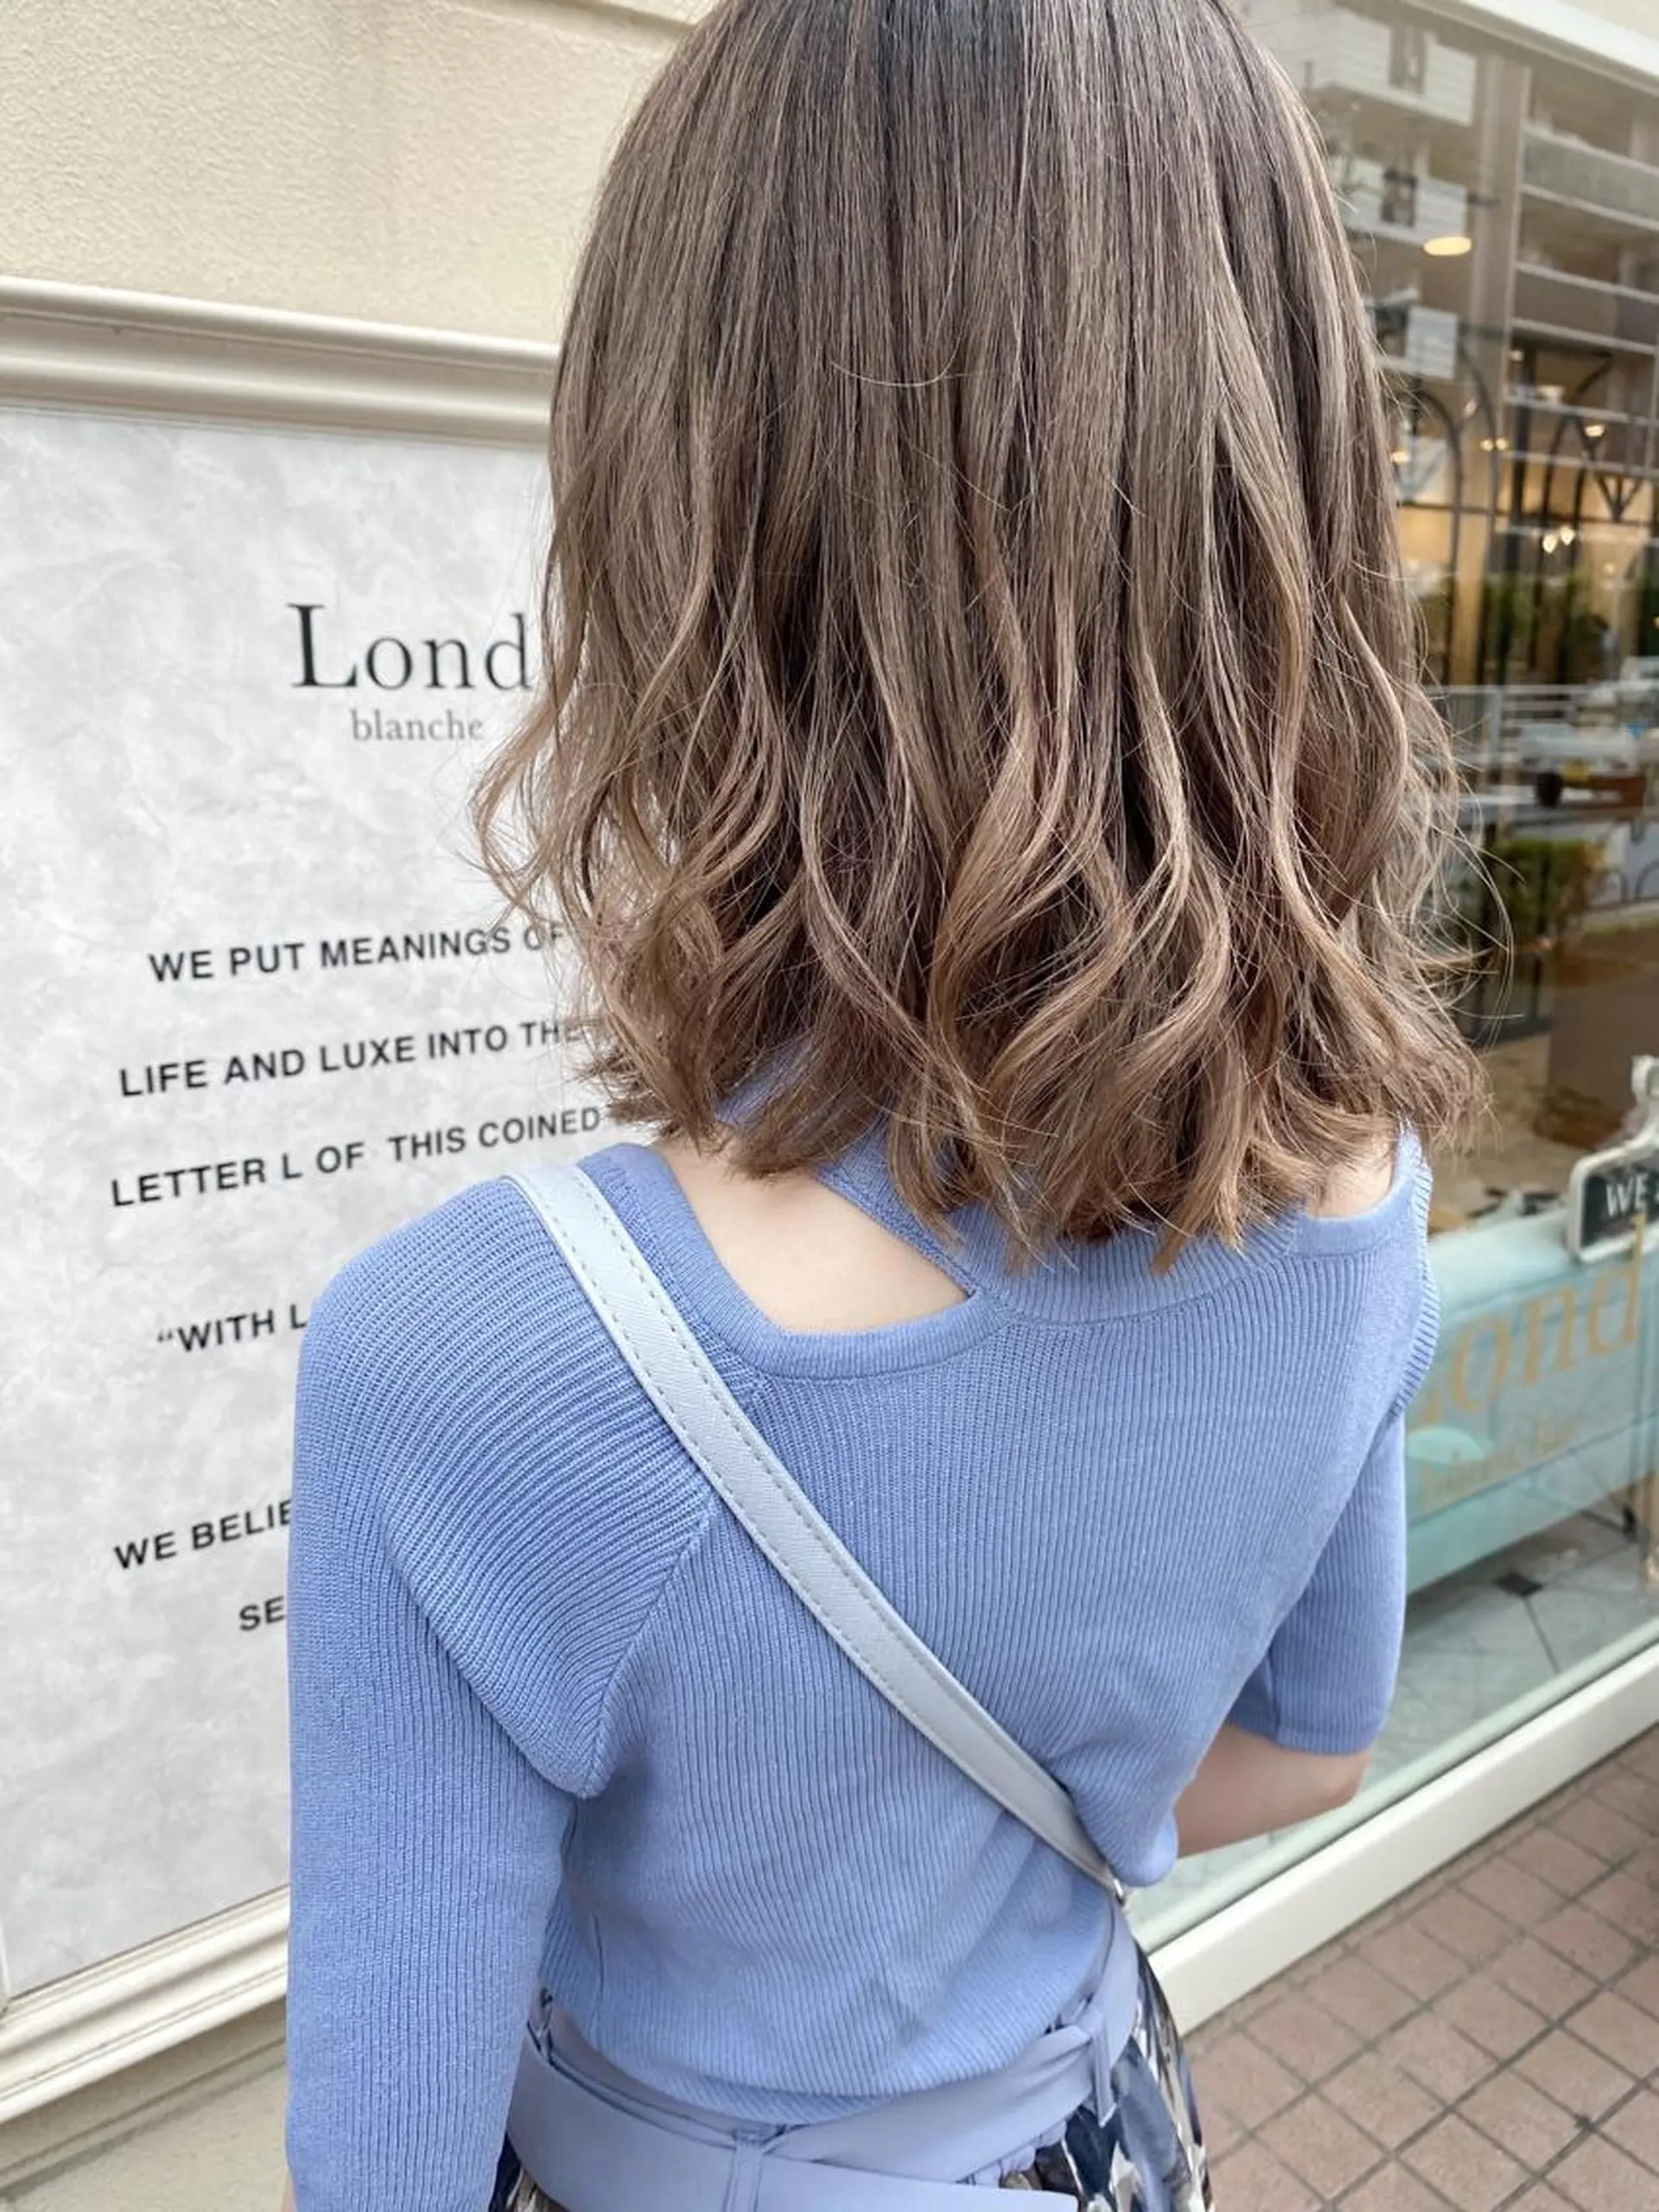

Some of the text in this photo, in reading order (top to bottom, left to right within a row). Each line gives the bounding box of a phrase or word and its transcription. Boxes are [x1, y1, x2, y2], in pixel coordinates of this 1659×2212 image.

[288, 602, 533, 690] Lond
[350, 709, 484, 741] blanche
[149, 950, 214, 982] WE
[229, 942, 305, 976] PUT
[320, 926, 511, 969] MEANINGS
[119, 1058, 208, 1097] LIFE
[224, 1048, 305, 1084] AND
[319, 1035, 416, 1072] LUXE
[428, 1025, 508, 1059] INTO
[111, 1107, 601, 1207] LETTER L OF THIS COINED
[1410, 1213, 1648, 1433] ond
[113, 1530, 177, 1570] WE
[238, 1595, 286, 1632] SE
